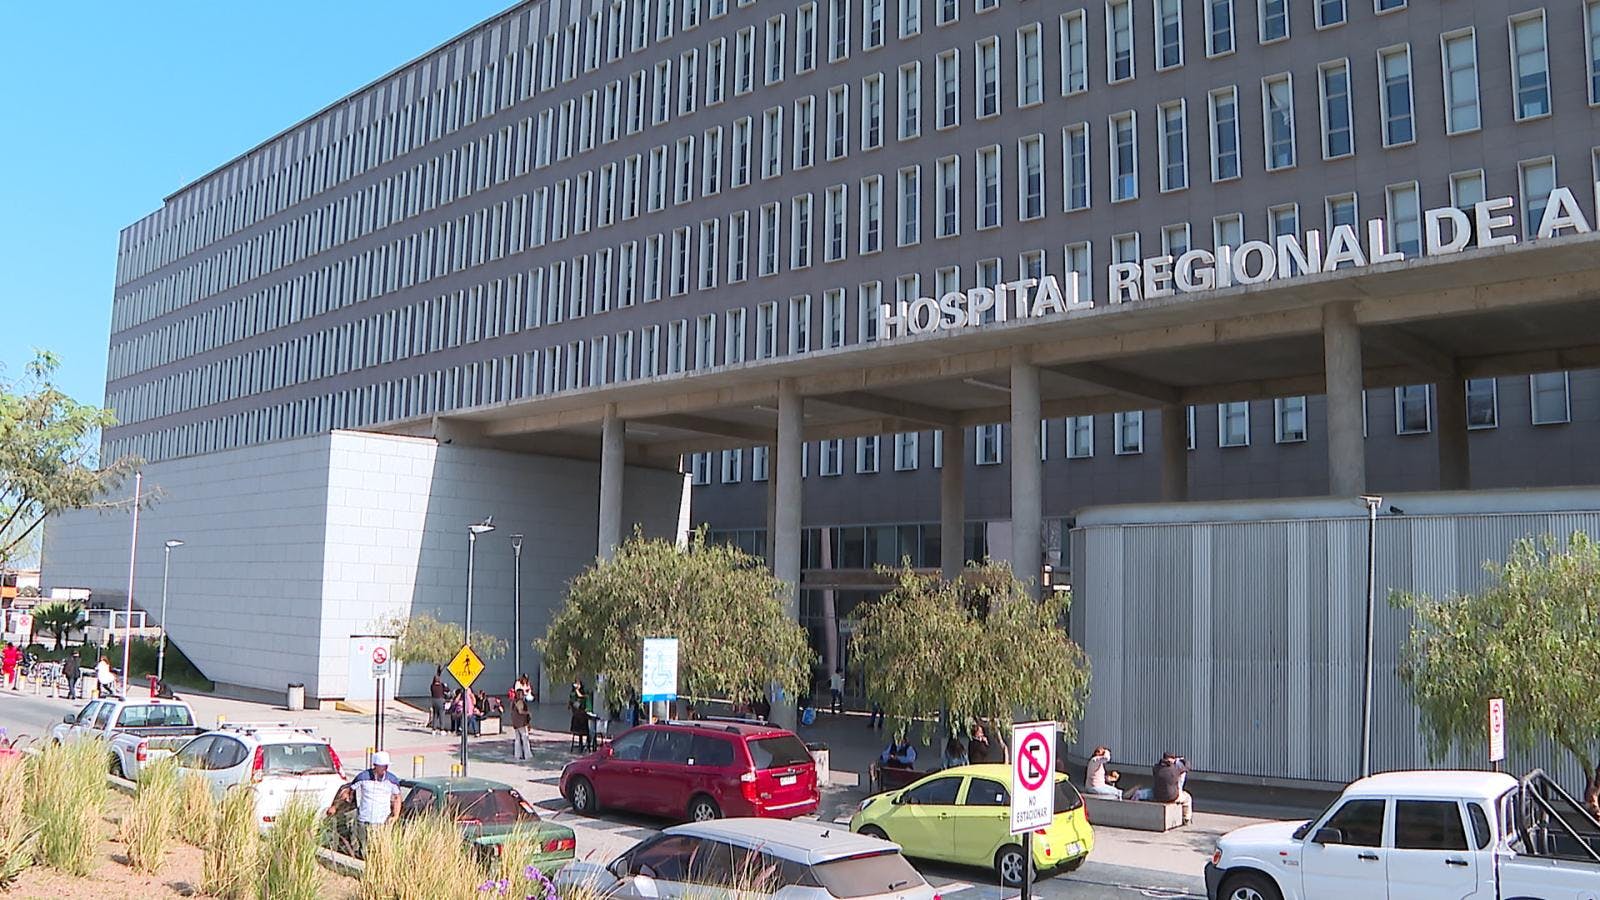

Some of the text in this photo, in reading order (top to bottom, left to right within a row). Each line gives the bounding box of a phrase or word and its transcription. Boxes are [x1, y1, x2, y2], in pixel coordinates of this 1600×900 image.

[880, 181, 1600, 340] HOSPITAL REGIONAL DE A
[1028, 796, 1037, 806] NO
[1016, 807, 1048, 823] ESTACIONAR
